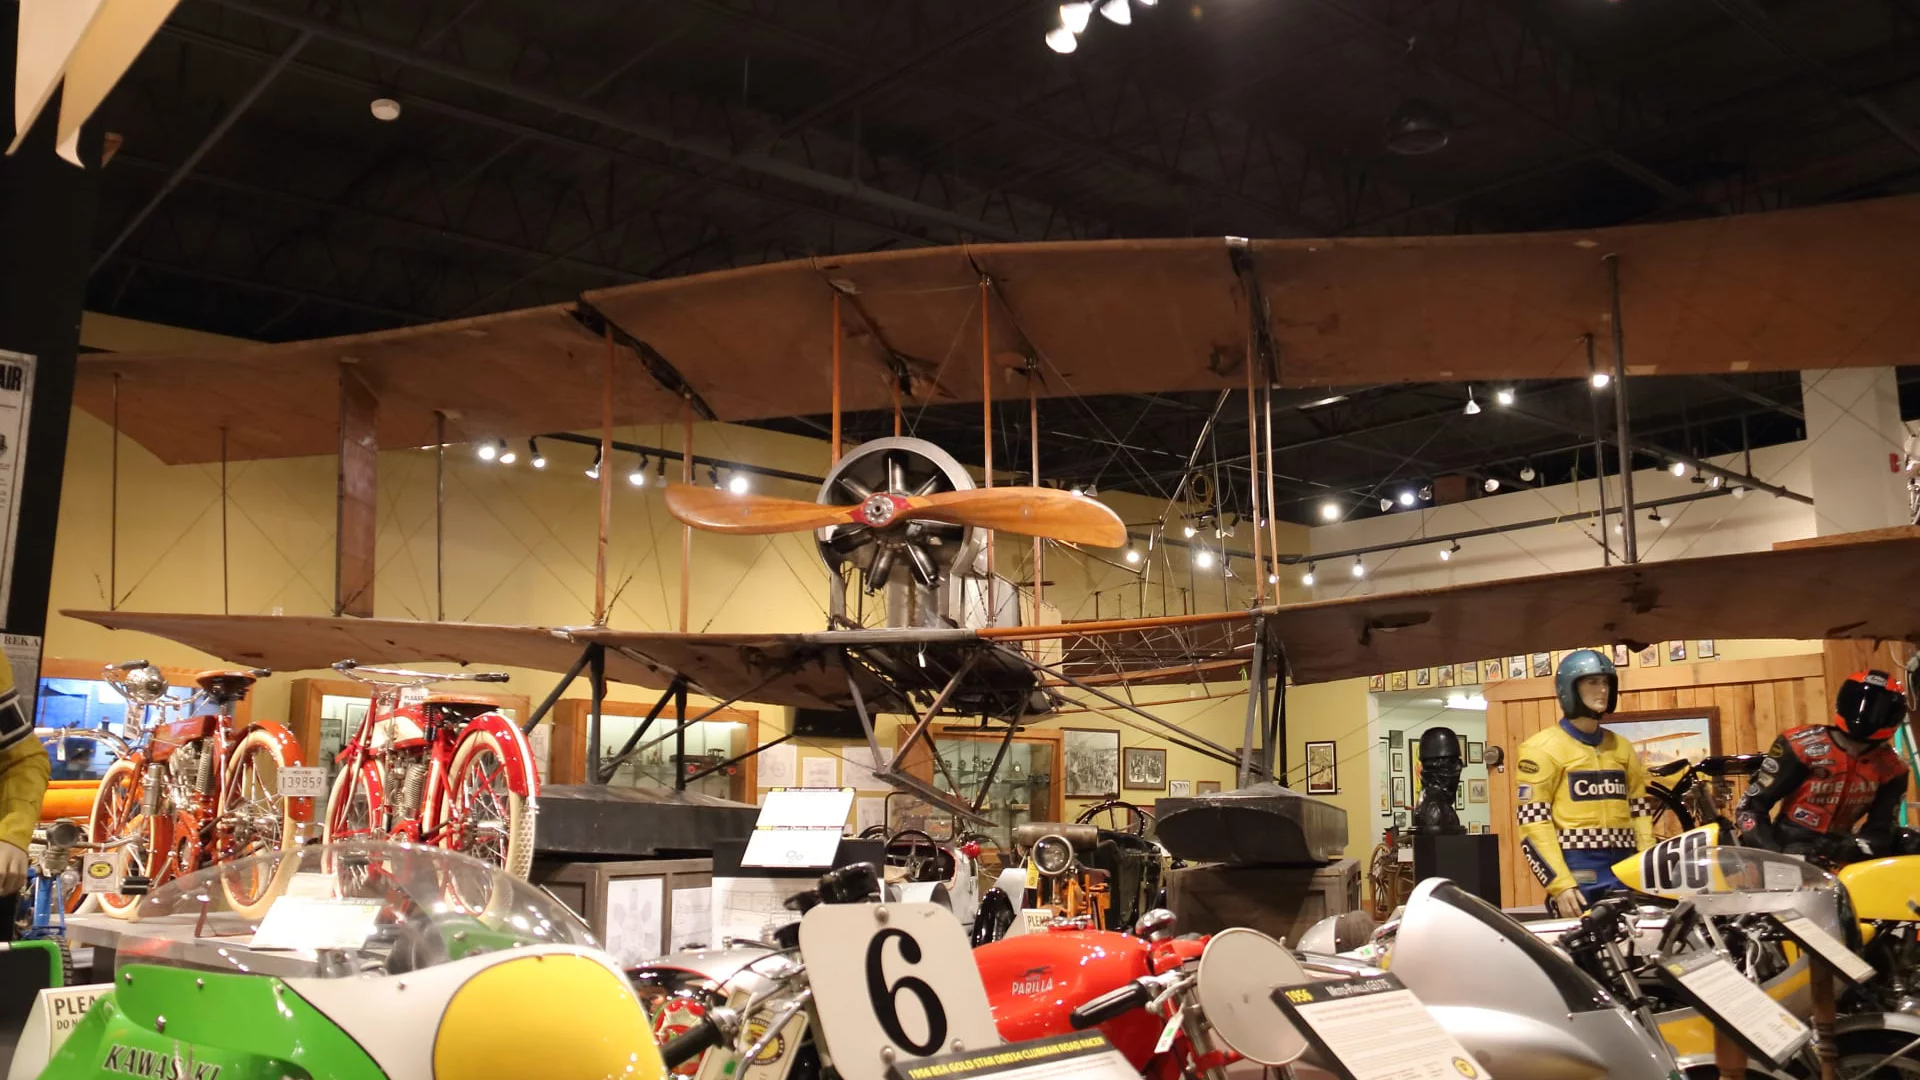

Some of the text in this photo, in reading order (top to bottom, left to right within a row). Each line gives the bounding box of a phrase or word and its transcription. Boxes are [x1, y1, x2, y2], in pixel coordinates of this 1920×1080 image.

[1574, 778, 1626, 796] Corbin
[1644, 831, 1709, 889] 160
[865, 927, 948, 1058] 6
[1011, 977, 1054, 997] PARILLA
[54, 995, 97, 1017] PLEA
[103, 1043, 222, 1080] KAWASKI
[929, 1064, 951, 1076] BSA
[948, 1060, 975, 1073] GOLD
[973, 1056, 997, 1069] STAR
[1021, 1044, 1060, 1060] CLUBMAN
[1058, 1040, 1082, 1053] ROAD
[1079, 1036, 1105, 1048] RACER
